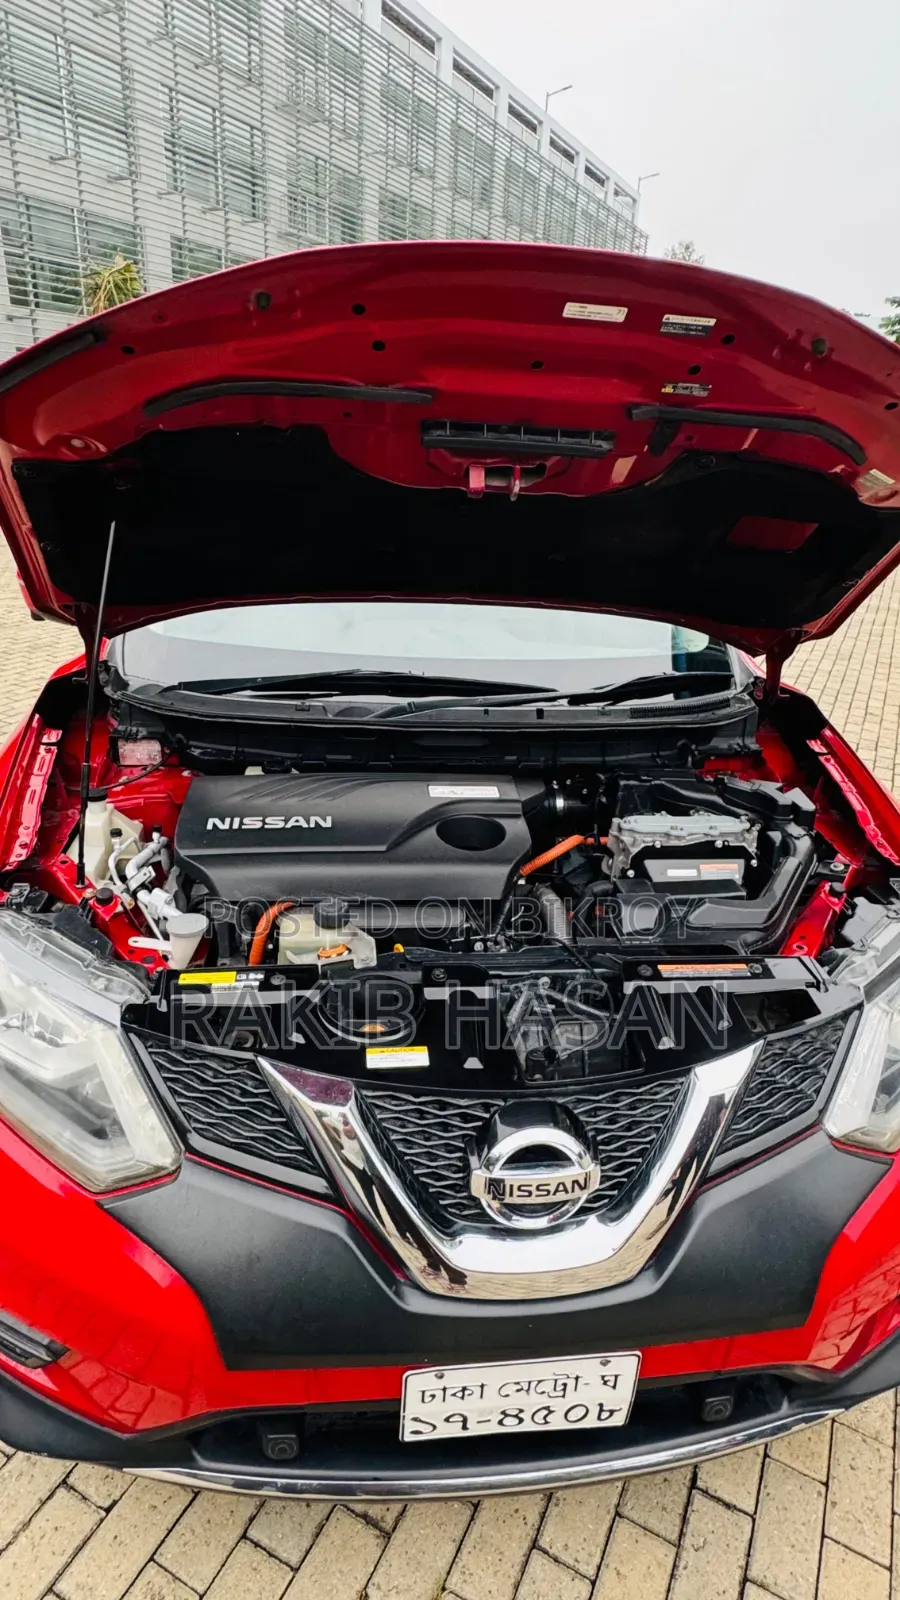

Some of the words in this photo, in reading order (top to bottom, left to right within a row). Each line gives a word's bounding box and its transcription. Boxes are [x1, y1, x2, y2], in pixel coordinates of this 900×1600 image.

[206, 815, 333, 830] NISSAN
[486, 1176, 589, 1201] NISSAN
[418, 1382, 488, 1405] ঢাকা
[409, 1402, 623, 1436] ১৭-৪৫০৮
